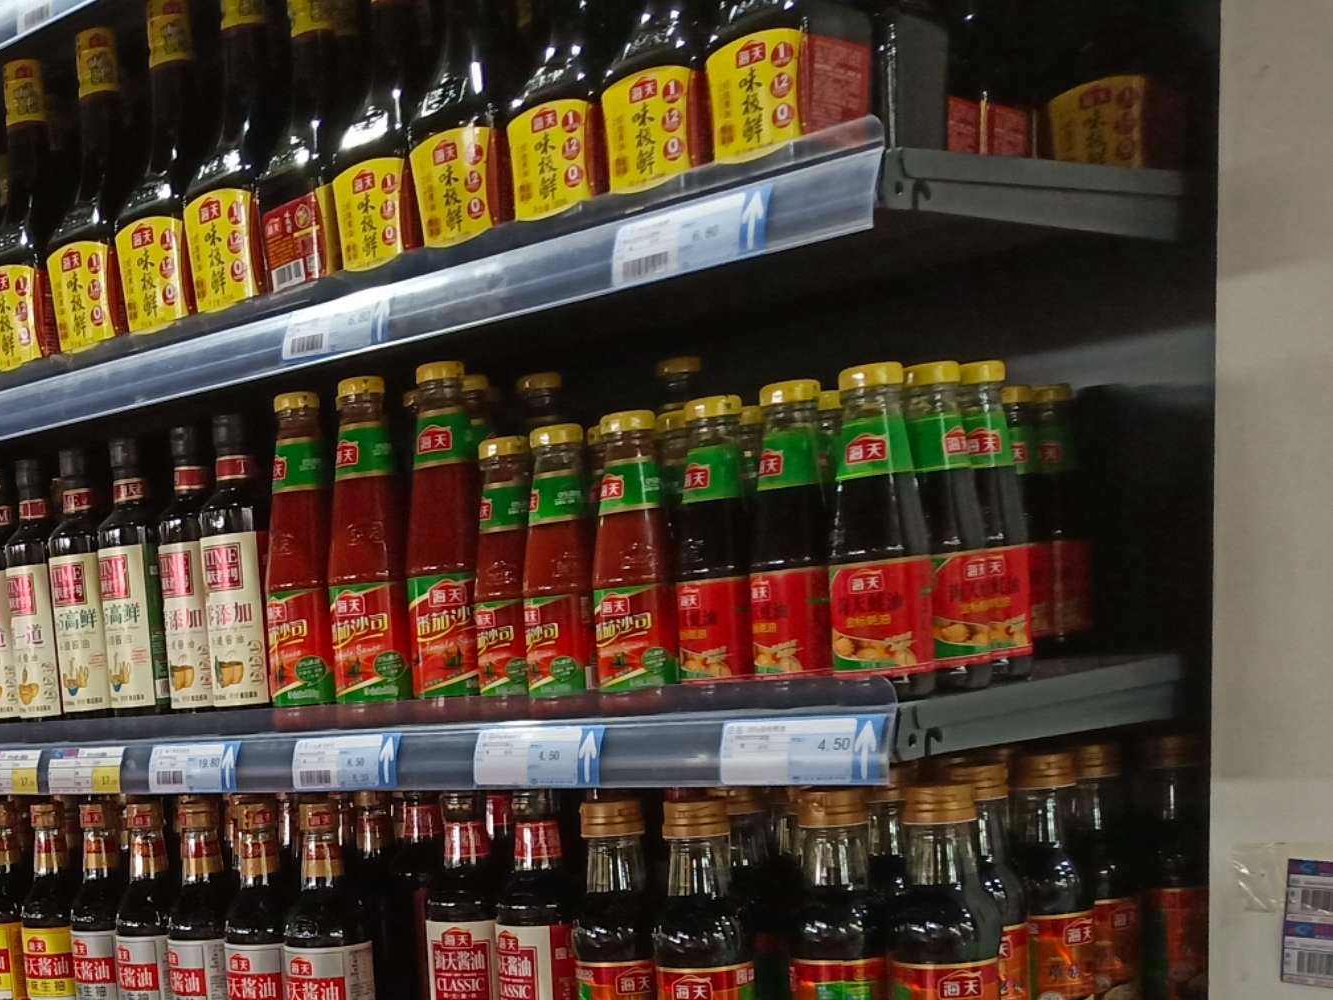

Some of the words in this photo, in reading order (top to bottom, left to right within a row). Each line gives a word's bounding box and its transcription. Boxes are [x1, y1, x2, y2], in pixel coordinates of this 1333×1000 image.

[739, 67, 763, 142] 味极鲜
[818, 738, 850, 751] 4.50
[437, 978, 484, 992] CLASSIC
[675, 985, 709, 999] 海天
[944, 982, 978, 997] 海天
